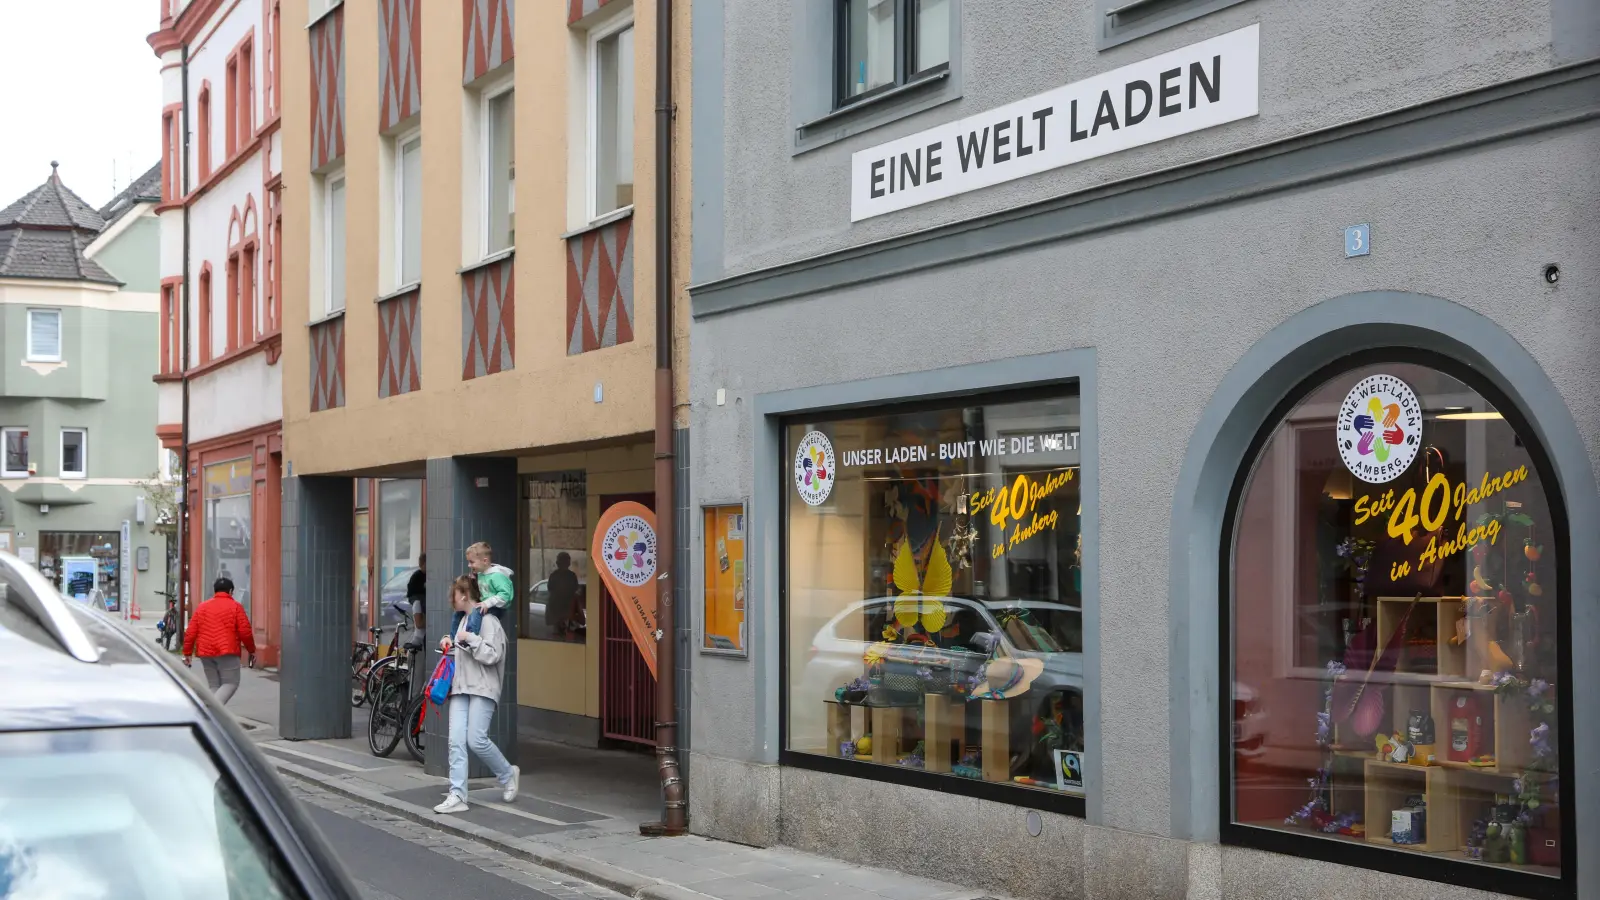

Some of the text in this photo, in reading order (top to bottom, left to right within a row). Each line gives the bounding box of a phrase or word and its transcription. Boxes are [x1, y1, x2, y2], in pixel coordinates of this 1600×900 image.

[870, 54, 1222, 200] EINE WELT LADEN
[1352, 229, 1363, 251] 3
[1343, 383, 1416, 431] EINE-WELT-LADEN
[797, 436, 832, 469] EINE-WELT-LADEN
[842, 449, 882, 467] UNSER
[885, 445, 928, 464] LADEN
[939, 441, 976, 460] BUNT
[980, 438, 1006, 457] WIE
[1011, 436, 1035, 455] DIE
[1040, 431, 1080, 453] WELT
[1355, 457, 1402, 475] AMBERG
[803, 488, 826, 500] AMBERG
[970, 467, 1074, 531] Seit 40 Jahren
[1354, 464, 1528, 546] Seit 40 Jahren
[992, 509, 1058, 559] in Amberg
[1390, 519, 1502, 582] in Amberg
